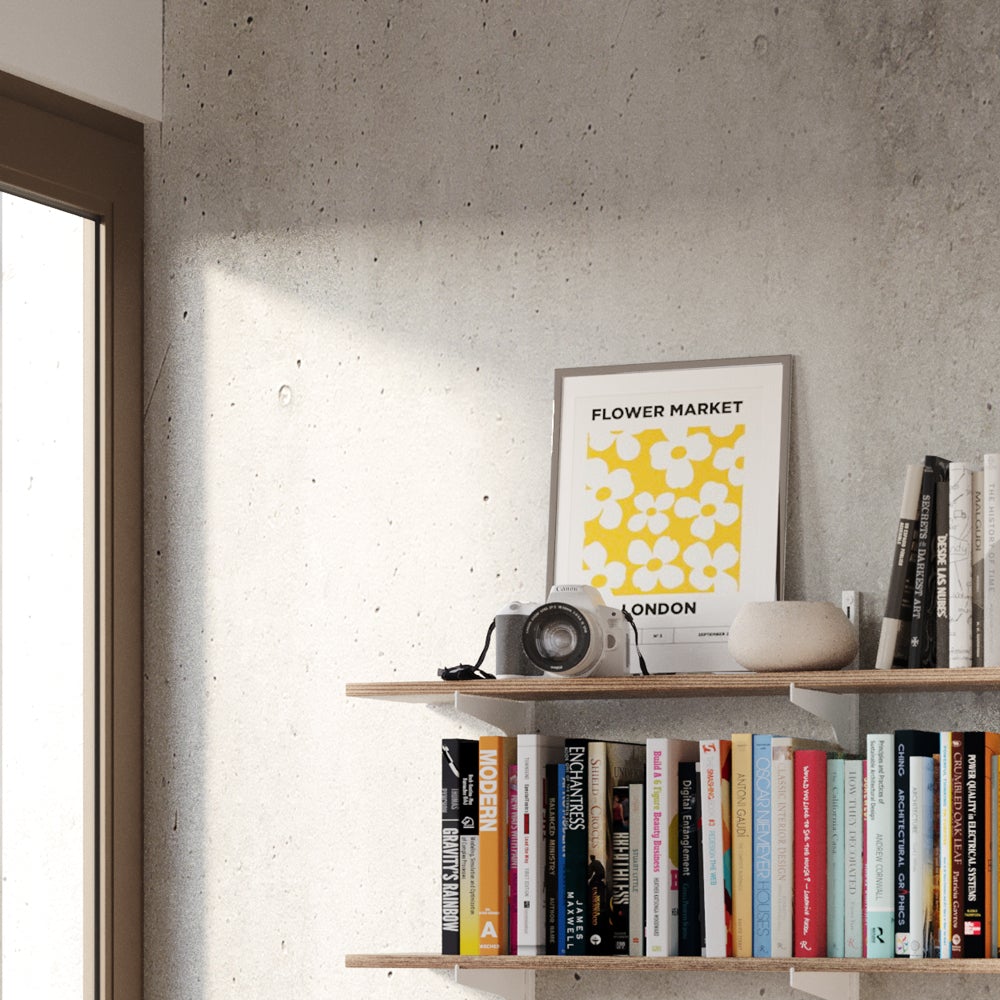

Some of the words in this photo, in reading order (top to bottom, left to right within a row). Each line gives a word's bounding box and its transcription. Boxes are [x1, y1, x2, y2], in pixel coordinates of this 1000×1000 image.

[592, 405, 665, 421] FLOWER
[670, 400, 743, 416] MARKET
[919, 494, 931, 539] SECRETS
[915, 549, 927, 597] DARKEST
[989, 552, 996, 564] OF
[937, 568, 948, 585] LAS
[912, 598, 922, 619] ART
[653, 751, 663, 770] Build
[877, 740, 885, 763] Principles
[897, 743, 905, 777] CHING
[968, 754, 977, 779] POWER
[480, 750, 498, 832] MODERN
[569, 746, 586, 831] ENCHANTRESS
[590, 758, 602, 796] SHIELD
[707, 768, 715, 800] SMASHING
[737, 772, 747, 807] ANTONI
[756, 758, 771, 808] OSCAR
[777, 762, 787, 801] CLASSIC
[848, 771, 857, 796] HOW
[953, 752, 963, 810] CRUMBLED
[651, 787, 662, 811] Figure
[680, 780, 693, 810] Digital
[831, 786, 841, 831] California
[869, 802, 877, 821] Design
[911, 786, 919, 834] ARCHITECTURE
[966, 780, 977, 812] QUALITY
[590, 805, 602, 848] CROCUS
[651, 812, 663, 839] Beauty
[777, 803, 787, 845] INTERIOR
[848, 799, 857, 827] THEY
[897, 788, 905, 868] ARCHITECTURAL
[953, 811, 963, 837] OAK
[443, 828, 459, 881] GRAVITY'S
[653, 840, 663, 873] Business
[680, 815, 693, 876] Entanglement
[756, 810, 771, 879] NIEMEYER
[831, 834, 840, 854] Casa
[875, 833, 884, 863] ANDREW
[953, 838, 963, 865] LEAF
[967, 821, 977, 866] ELECTRICAL
[777, 847, 787, 881] DESIGN
[848, 831, 857, 896] DECORATED
[875, 864, 884, 901] CORNWALL
[952, 871, 960, 899] Patricia
[967, 867, 977, 902] SYSTEMS
[443, 884, 459, 932] RAINBOW
[566, 891, 575, 950] MAXWELL
[576, 900, 584, 940] JAMES
[756, 881, 770, 937] HOUSES
